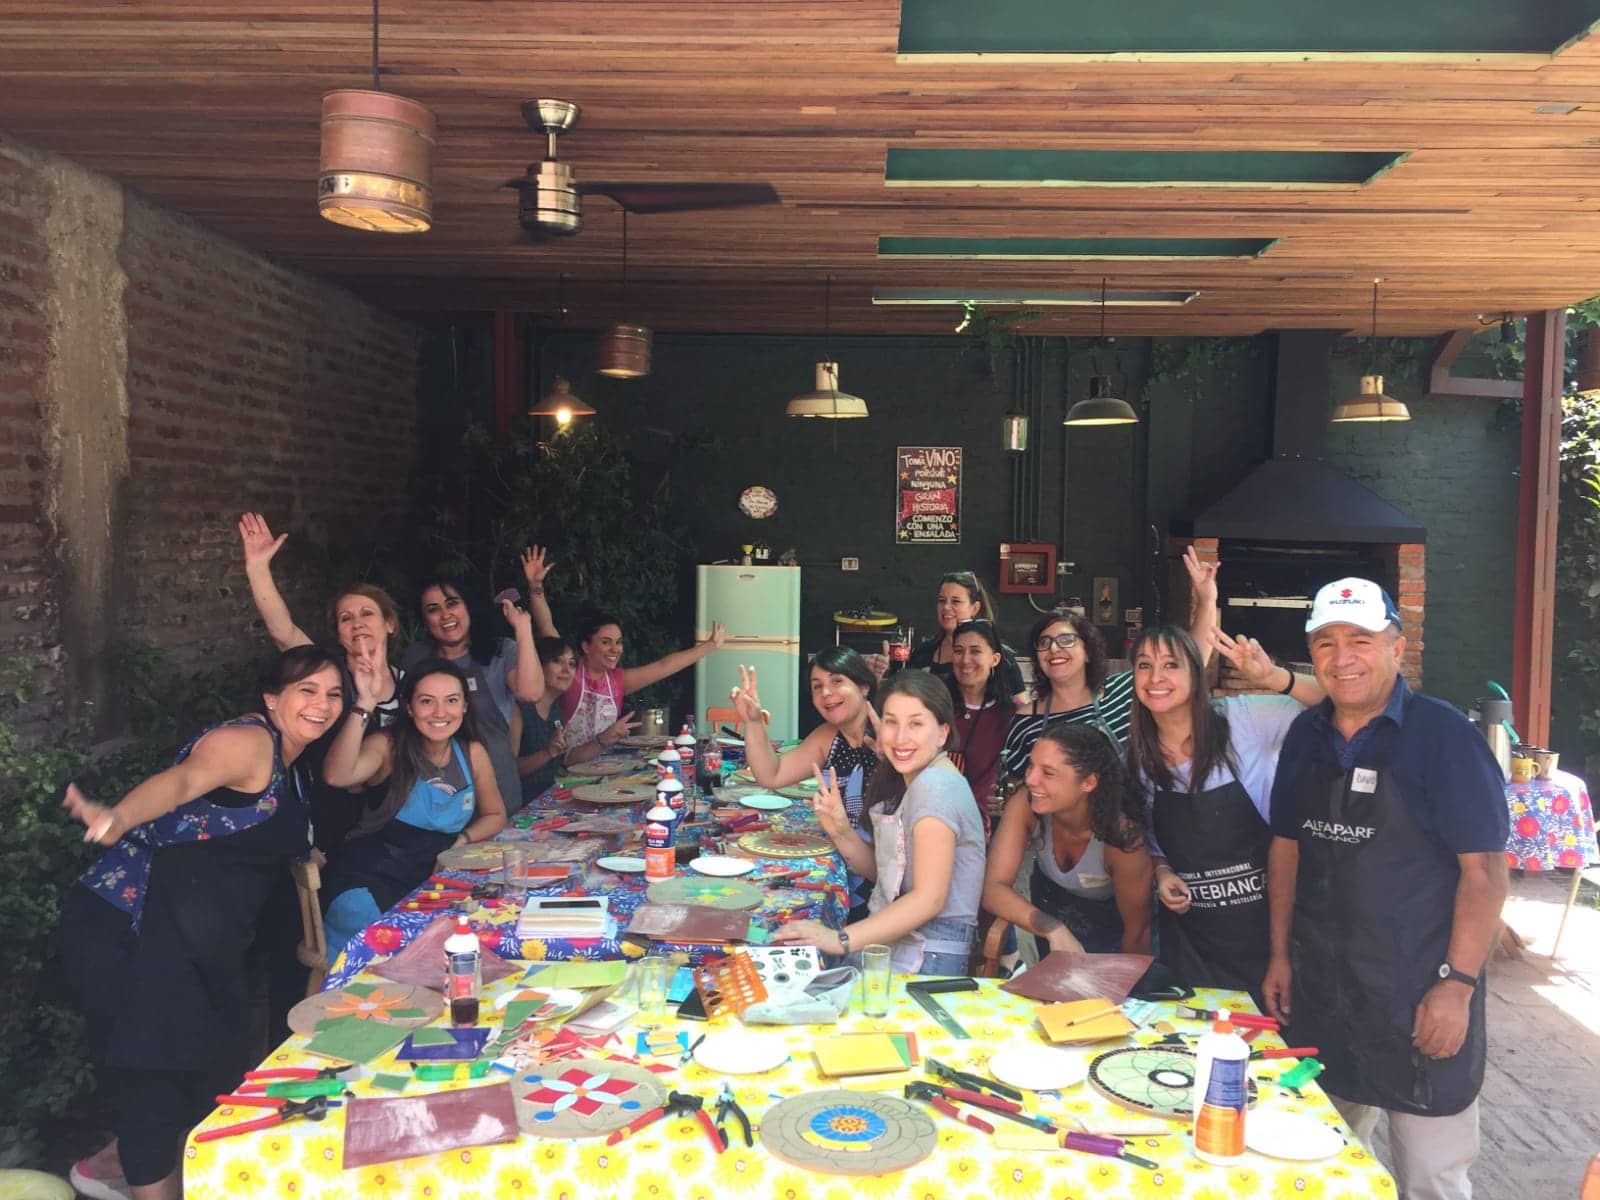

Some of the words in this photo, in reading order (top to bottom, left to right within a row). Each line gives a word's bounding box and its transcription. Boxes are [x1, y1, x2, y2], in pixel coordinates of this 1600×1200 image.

[925, 449, 956, 467] VINO
[912, 503, 949, 514] HISTORIA
[914, 530, 955, 538] ENSALADA
[1302, 819, 1376, 839] ALFAPARF
[1204, 862, 1252, 878] INTERNACIONAL
